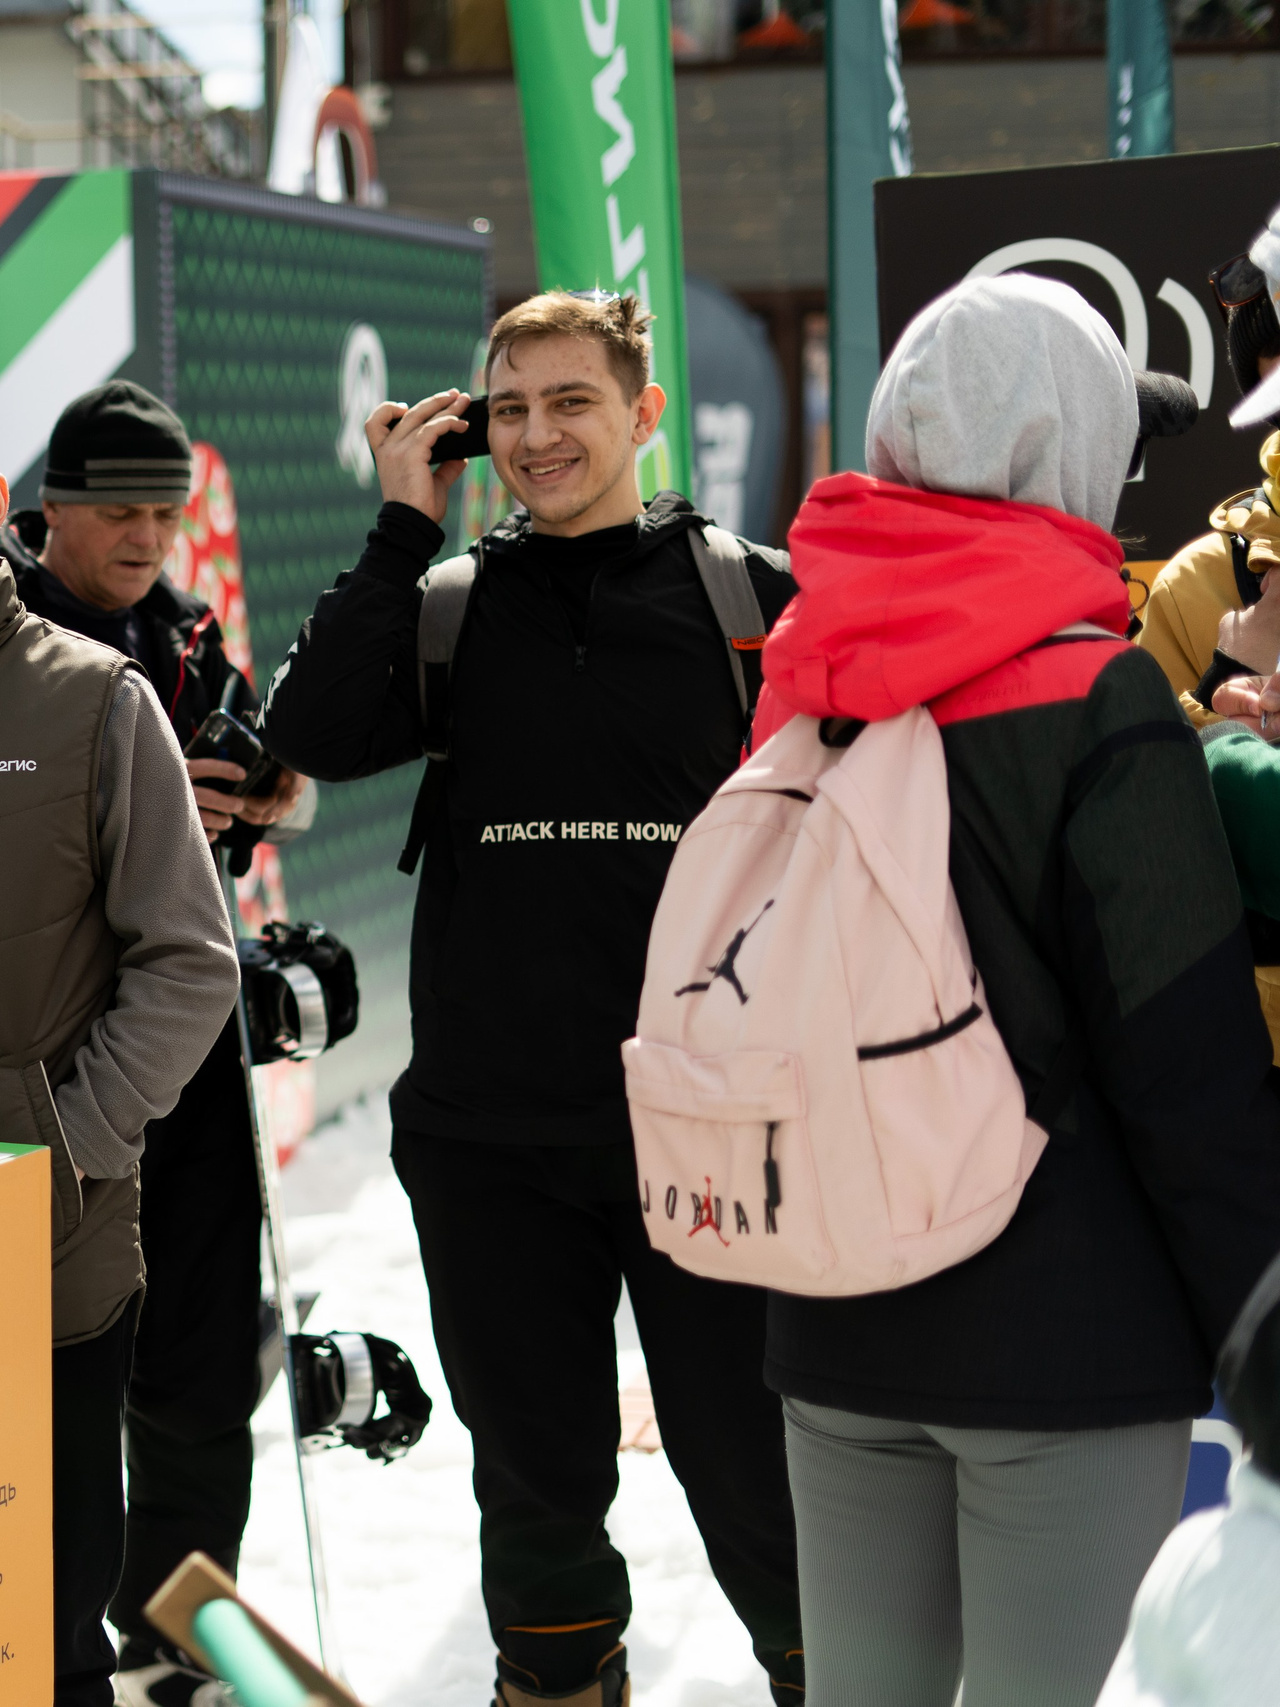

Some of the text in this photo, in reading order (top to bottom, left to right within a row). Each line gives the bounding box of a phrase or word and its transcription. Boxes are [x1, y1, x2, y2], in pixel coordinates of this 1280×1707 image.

[480, 821, 682, 843] ATTACK HERE NOW
